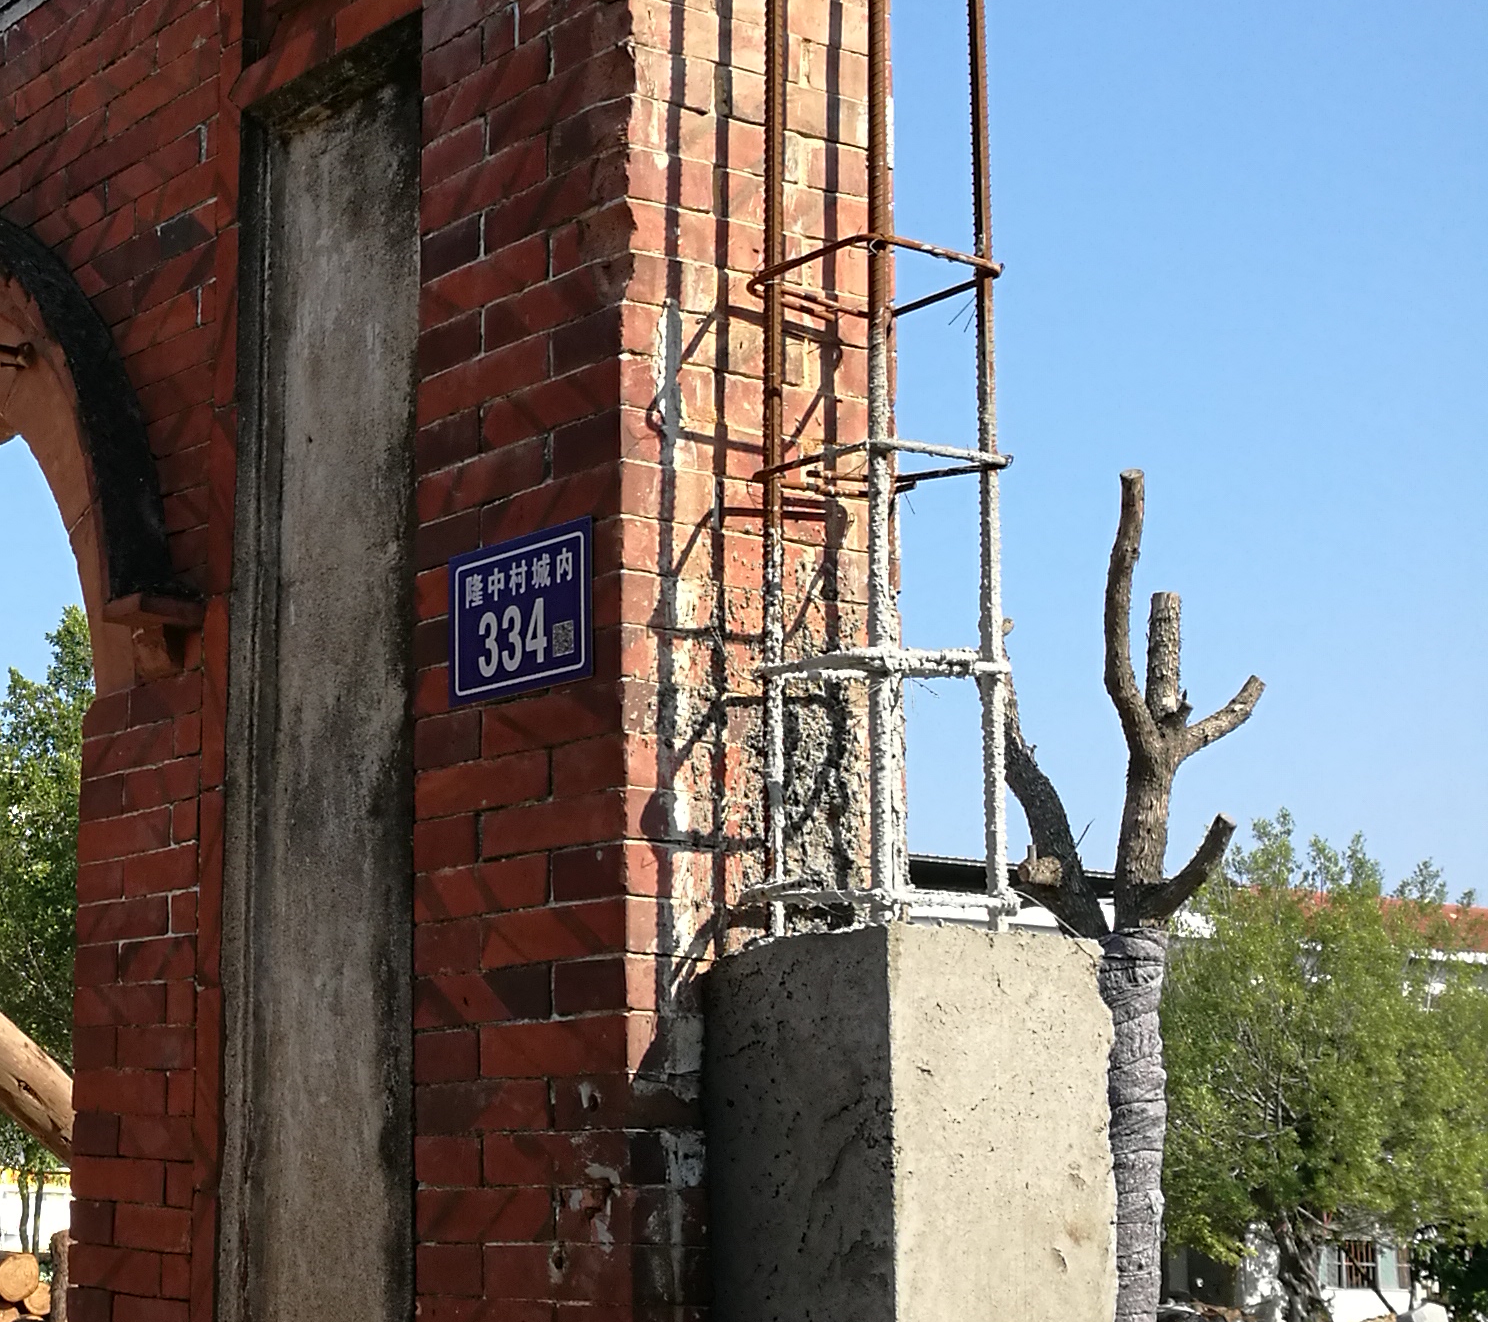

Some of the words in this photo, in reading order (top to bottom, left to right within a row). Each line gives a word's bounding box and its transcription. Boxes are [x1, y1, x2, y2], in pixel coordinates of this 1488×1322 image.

[465, 547, 573, 609] 隆中村城内
[478, 597, 547, 677] 334
